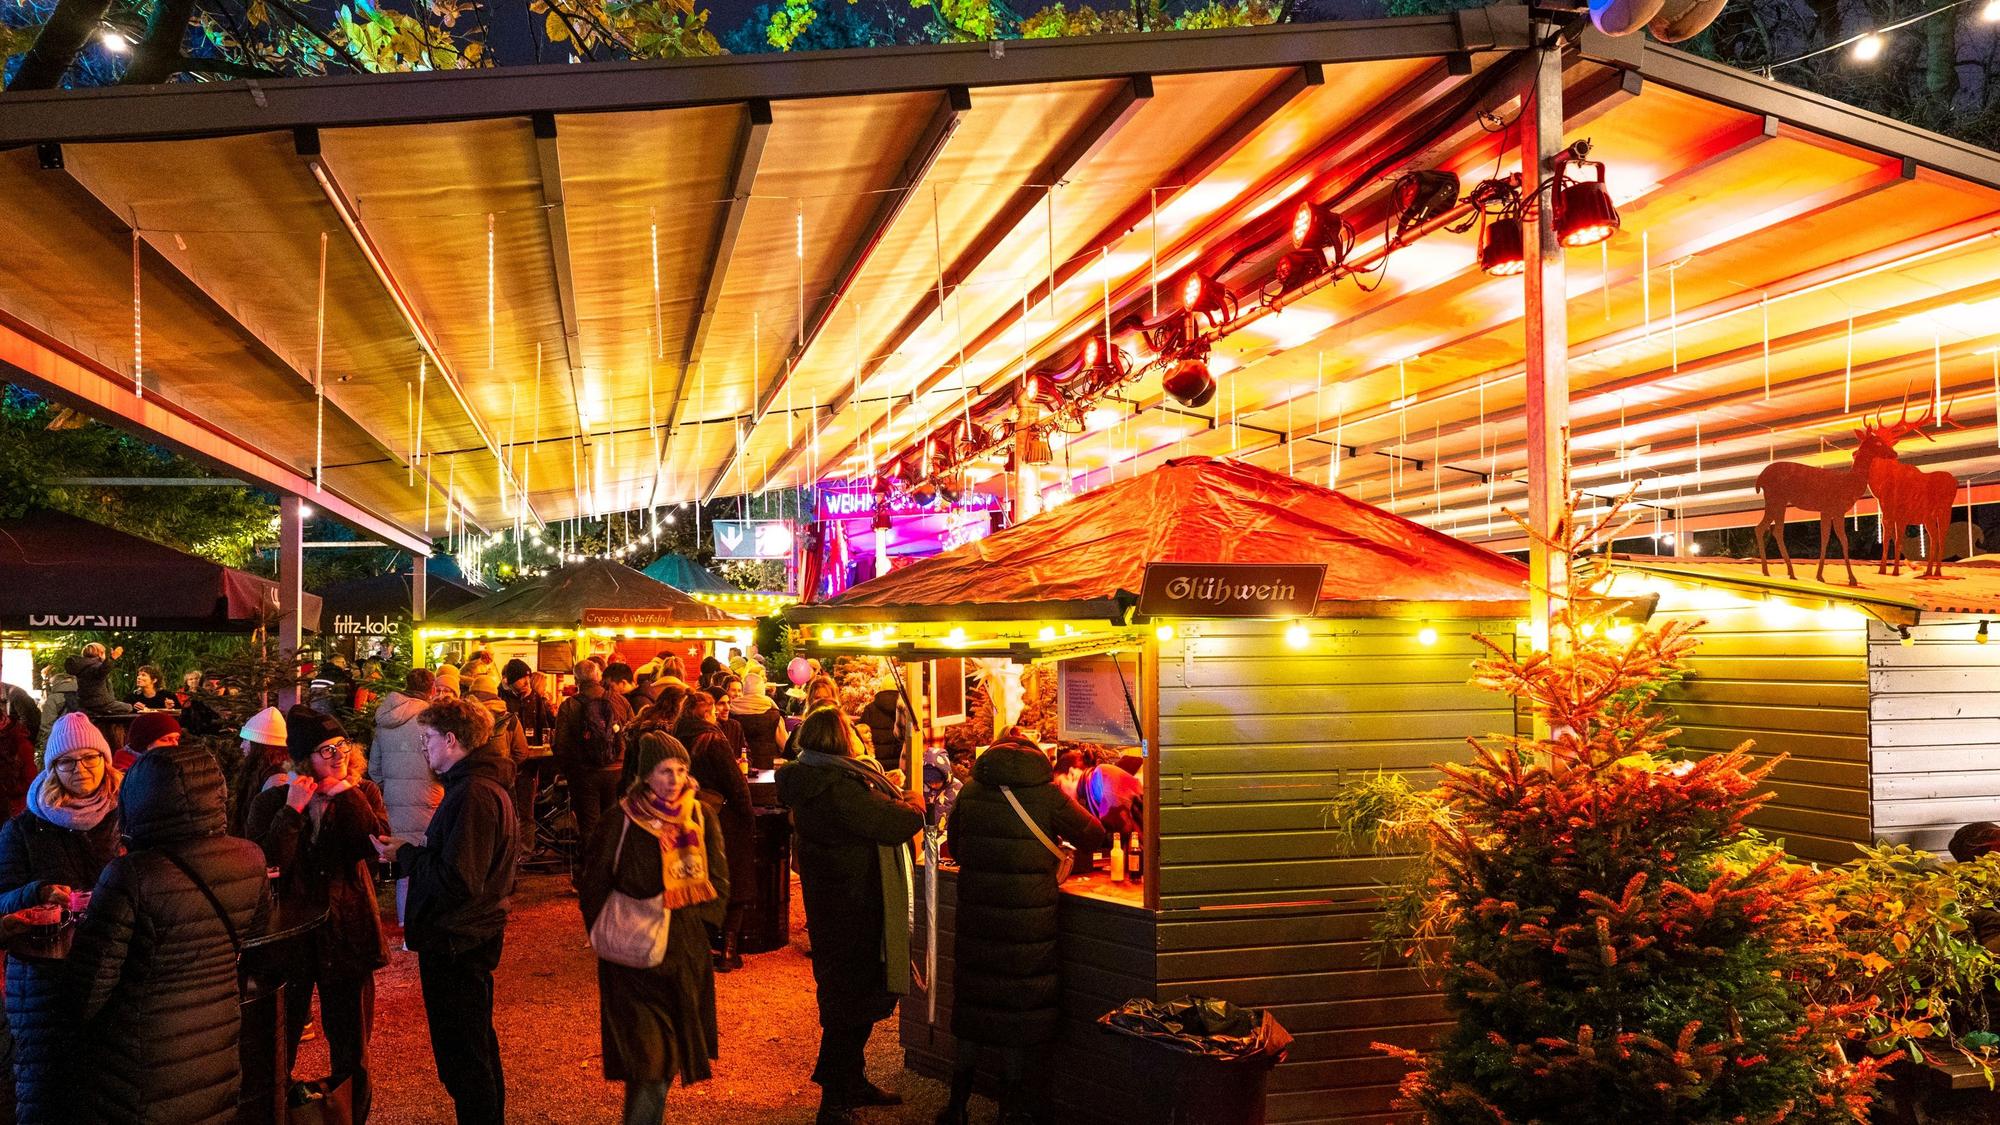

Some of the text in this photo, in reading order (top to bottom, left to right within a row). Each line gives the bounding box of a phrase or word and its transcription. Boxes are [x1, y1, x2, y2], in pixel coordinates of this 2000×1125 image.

[1165, 576, 1295, 605] Glühwein
[334, 614, 399, 634] fritz-kola
[630, 614, 666, 623] Waffeln
